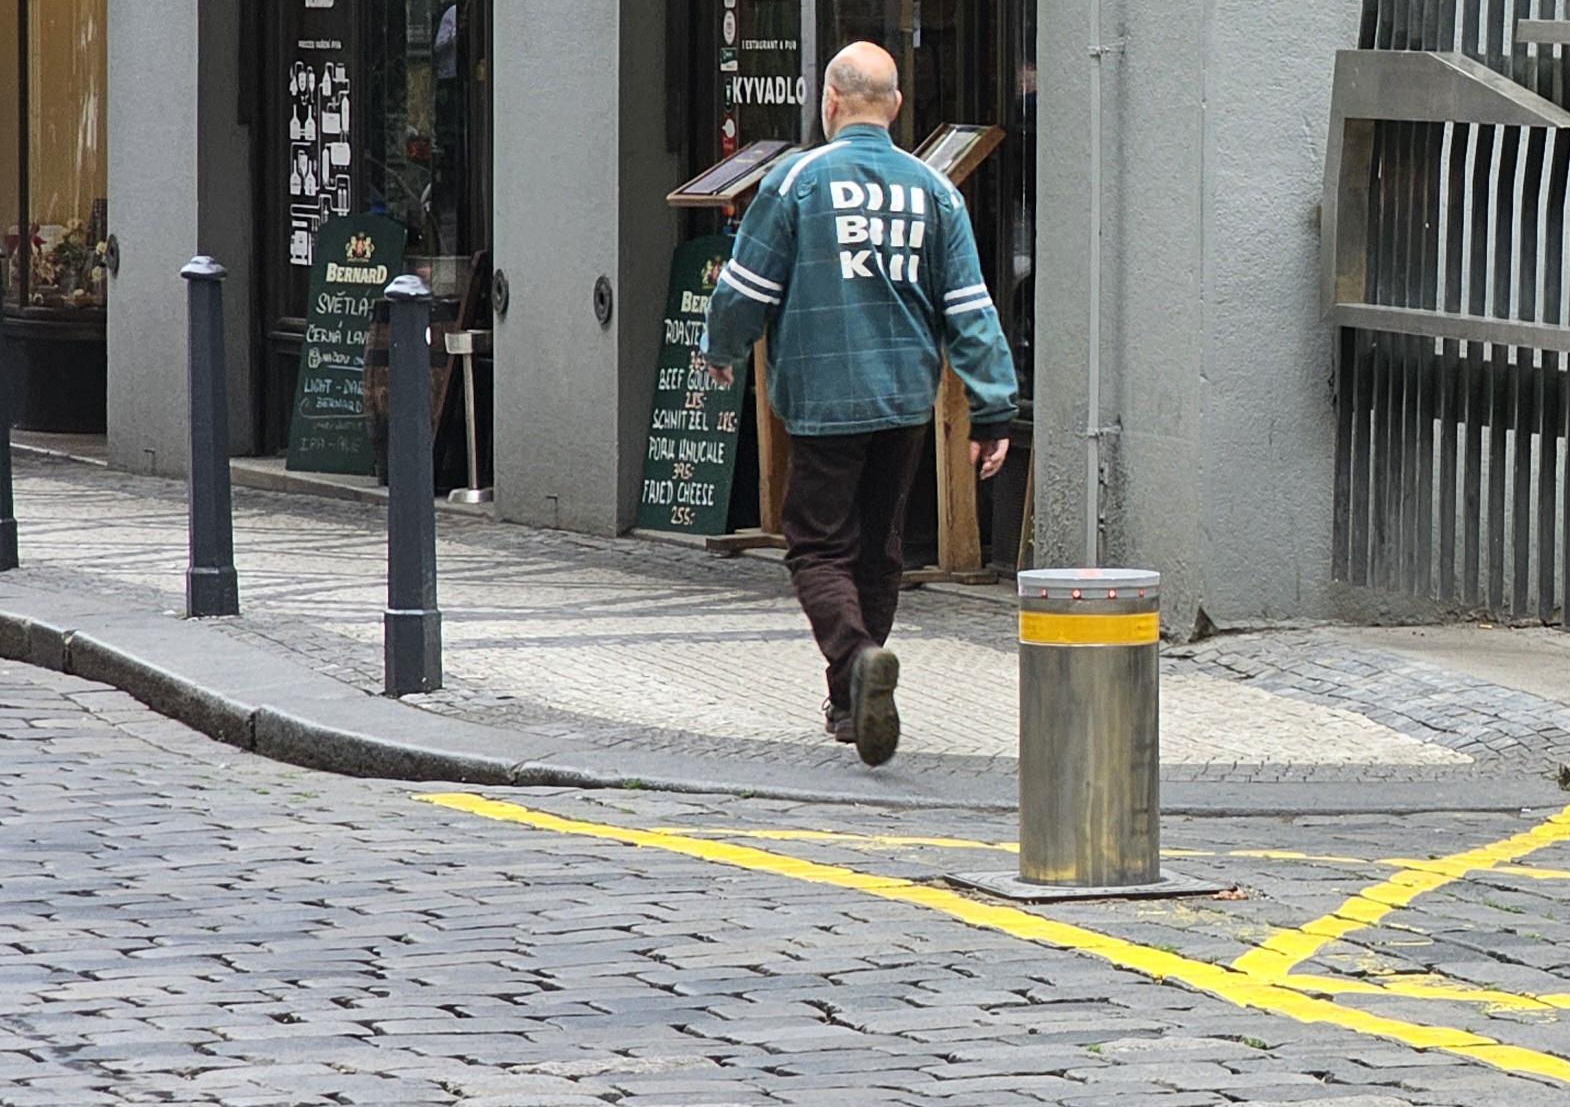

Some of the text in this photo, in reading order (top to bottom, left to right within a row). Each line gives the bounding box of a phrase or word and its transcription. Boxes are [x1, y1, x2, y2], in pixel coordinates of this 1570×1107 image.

[732, 76, 808, 105] KYVADLO
[325, 263, 388, 284] BERNARD
[658, 368, 685, 390] BEEF
[652, 408, 709, 432] SCHNITZEL
[677, 481, 715, 506] CHEESE
